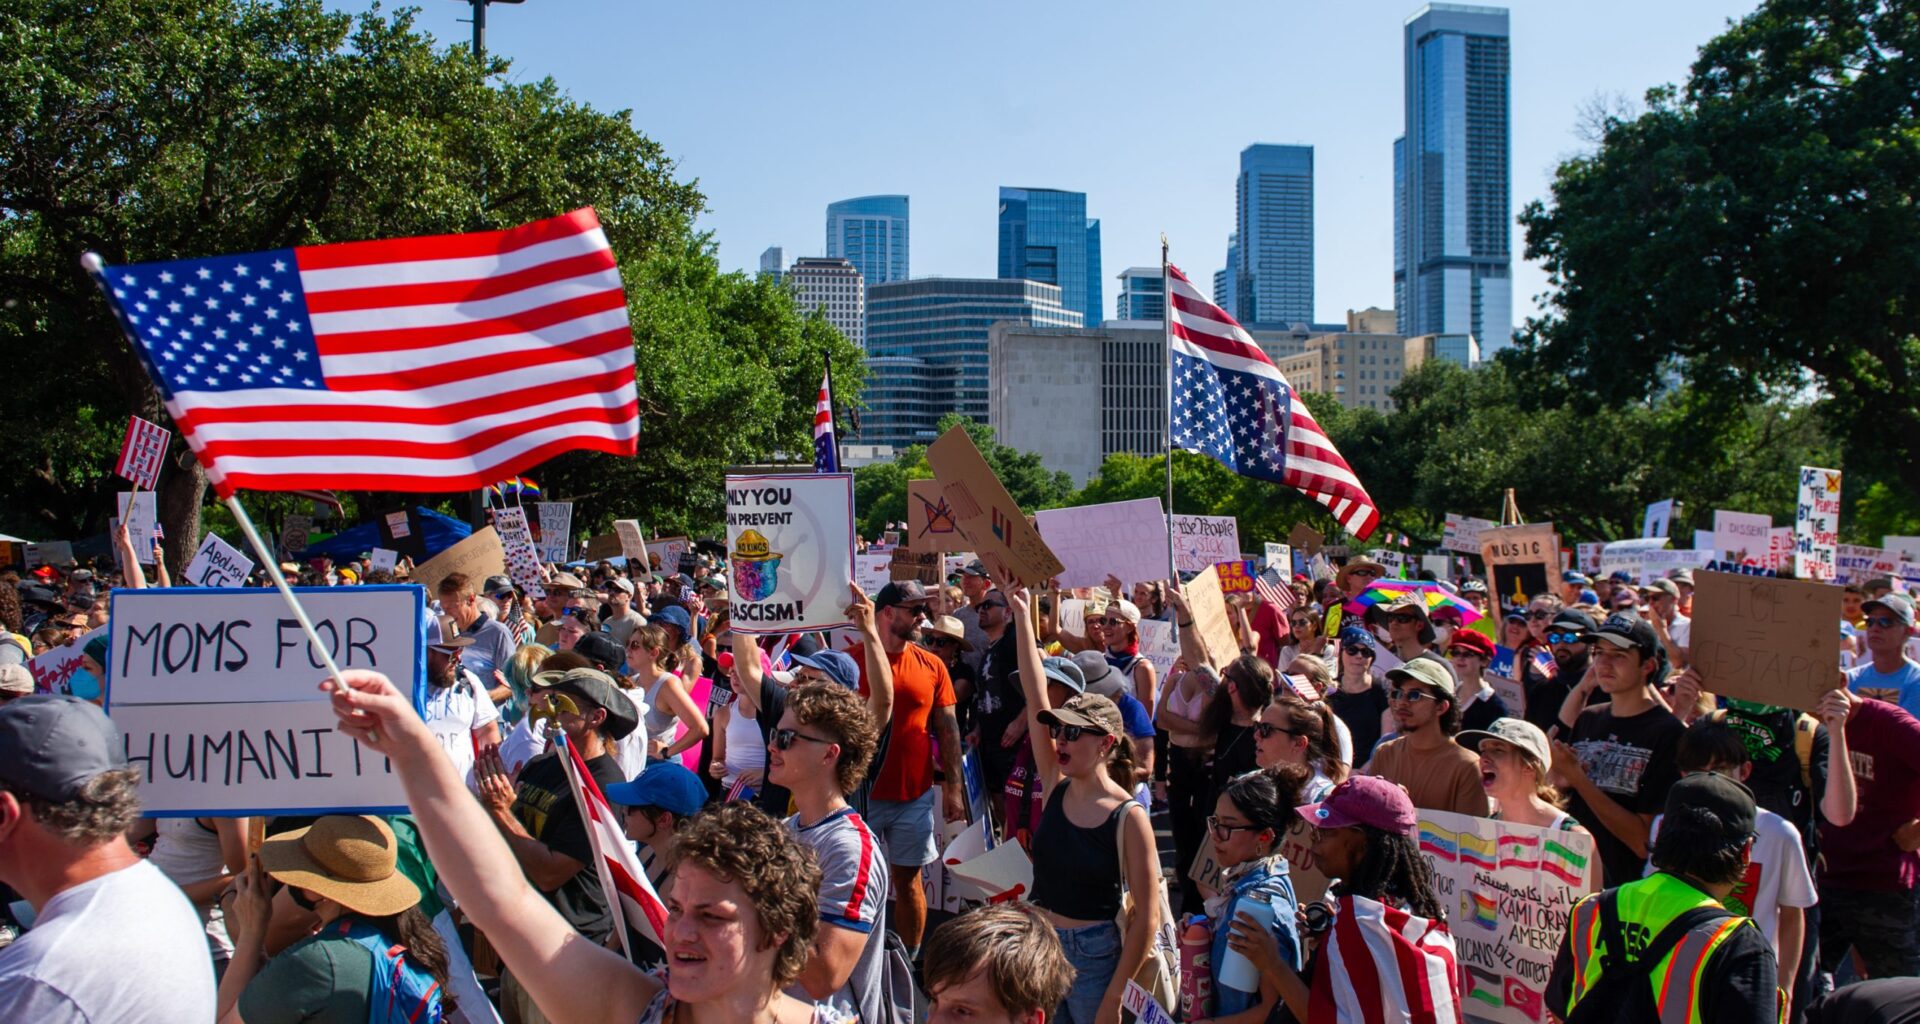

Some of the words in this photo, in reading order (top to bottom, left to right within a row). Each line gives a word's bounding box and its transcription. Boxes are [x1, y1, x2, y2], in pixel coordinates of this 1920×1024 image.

[1802, 470, 1818, 485] OF
[751, 488, 792, 506] YOU
[1810, 486, 1824, 499] THE
[1799, 503, 1812, 521] BY
[1815, 499, 1840, 514] PEOPLE
[726, 513, 737, 525] AN
[739, 512, 792, 526] PREVENT
[1810, 518, 1826, 532] THE
[1729, 522, 1768, 538] DISSENT
[1814, 532, 1838, 545] PEOPLE
[737, 543, 746, 552] NO
[747, 541, 767, 552] KINGS
[1173, 536, 1189, 551] RE
[1195, 537, 1224, 554] SICK
[1490, 540, 1540, 558] MUSIC
[1797, 533, 1812, 554] FOR
[200, 540, 245, 582] ABOLISH
[546, 548, 565, 562] ICE
[1174, 554, 1195, 570] HIS
[1814, 548, 1831, 563] THE
[1219, 564, 1242, 577] BE
[1803, 559, 1832, 577] PEOPLE
[1873, 561, 1895, 572] AND
[200, 565, 230, 587] ICE
[1727, 579, 1789, 624] ICE
[1065, 608, 1085, 629] KIN
[122, 619, 252, 678] MOMS
[275, 617, 378, 669] FOR
[1146, 654, 1174, 666] PEOPL
[1694, 639, 1830, 693] GESTAPO
[123, 728, 393, 786] HUMANI
[1199, 858, 1220, 889] PA
[1498, 893, 1533, 927] KAMI
[1536, 908, 1570, 932] ORAN
[1509, 926, 1562, 951] AMERIK
[1456, 936, 1496, 969] RICANS
[1494, 935, 1518, 969] biz
[1516, 953, 1554, 984] ameri
